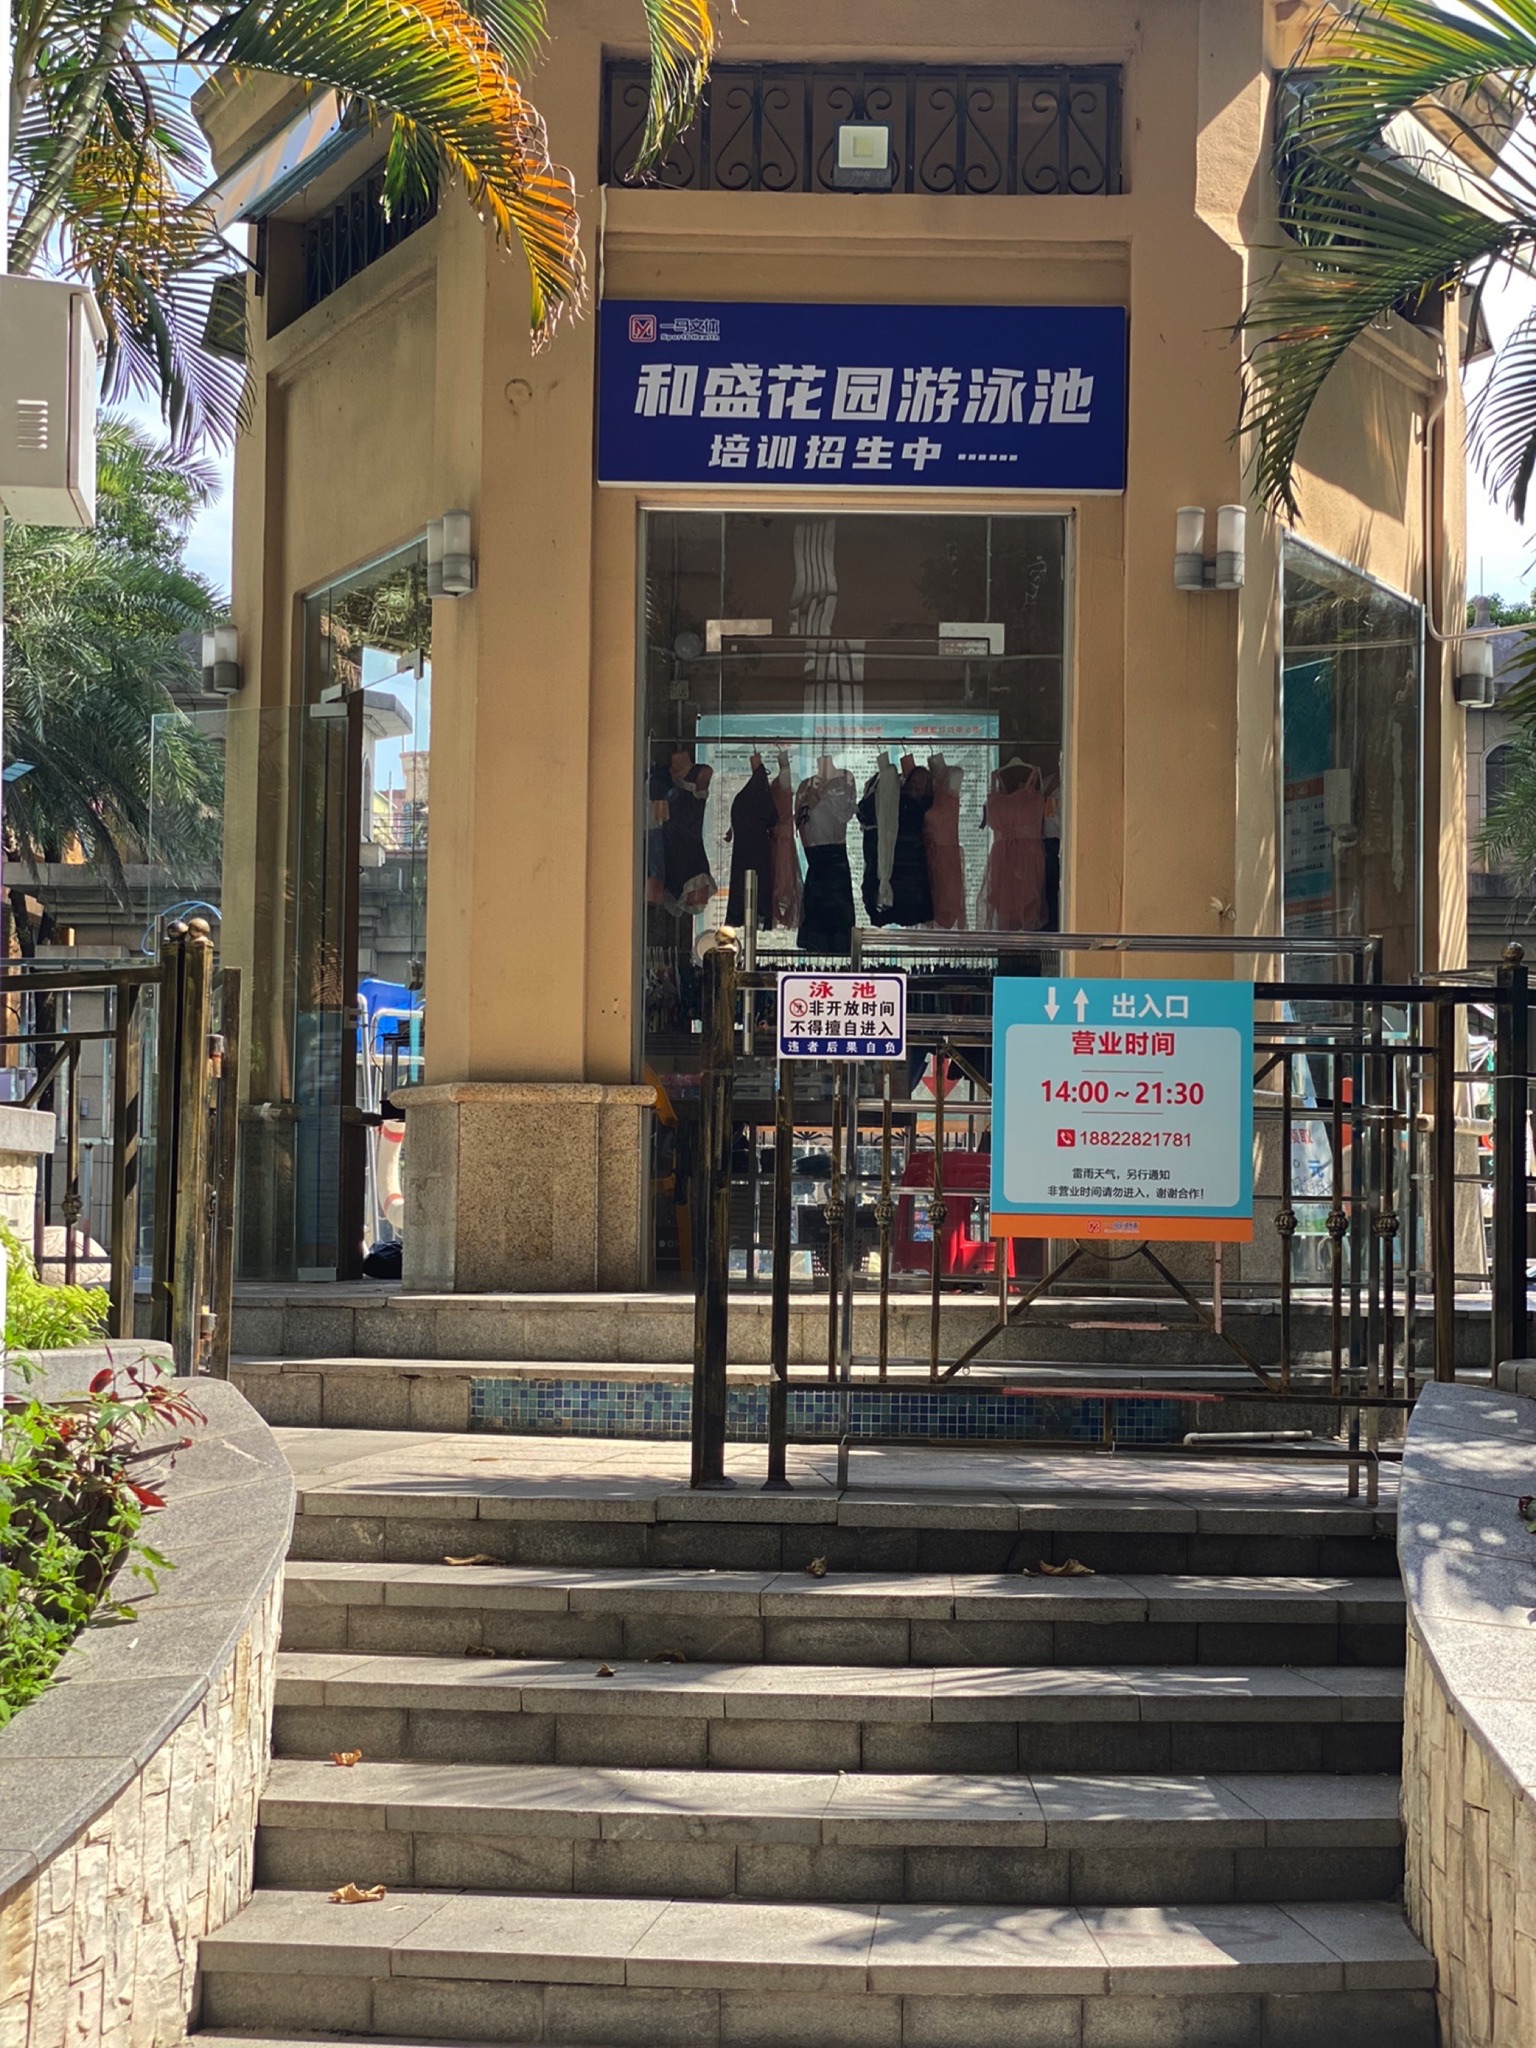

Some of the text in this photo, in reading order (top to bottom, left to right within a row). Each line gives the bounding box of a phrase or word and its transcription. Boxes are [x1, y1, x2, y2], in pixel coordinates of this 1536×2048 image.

[634, 363, 1094, 424] 和盛花园游泳池
[809, 1000, 895, 1017] 非开放时间
[1112, 993, 1189, 1019] 出入口
[790, 1020, 893, 1036] 不得擅自进入
[787, 1040, 896, 1054] 违者后果自负
[1071, 1031, 1175, 1057] 营业时间
[1080, 1131, 1191, 1147] 18822821781
[1072, 1168, 1170, 1180] 雷雨天气，另行通知
